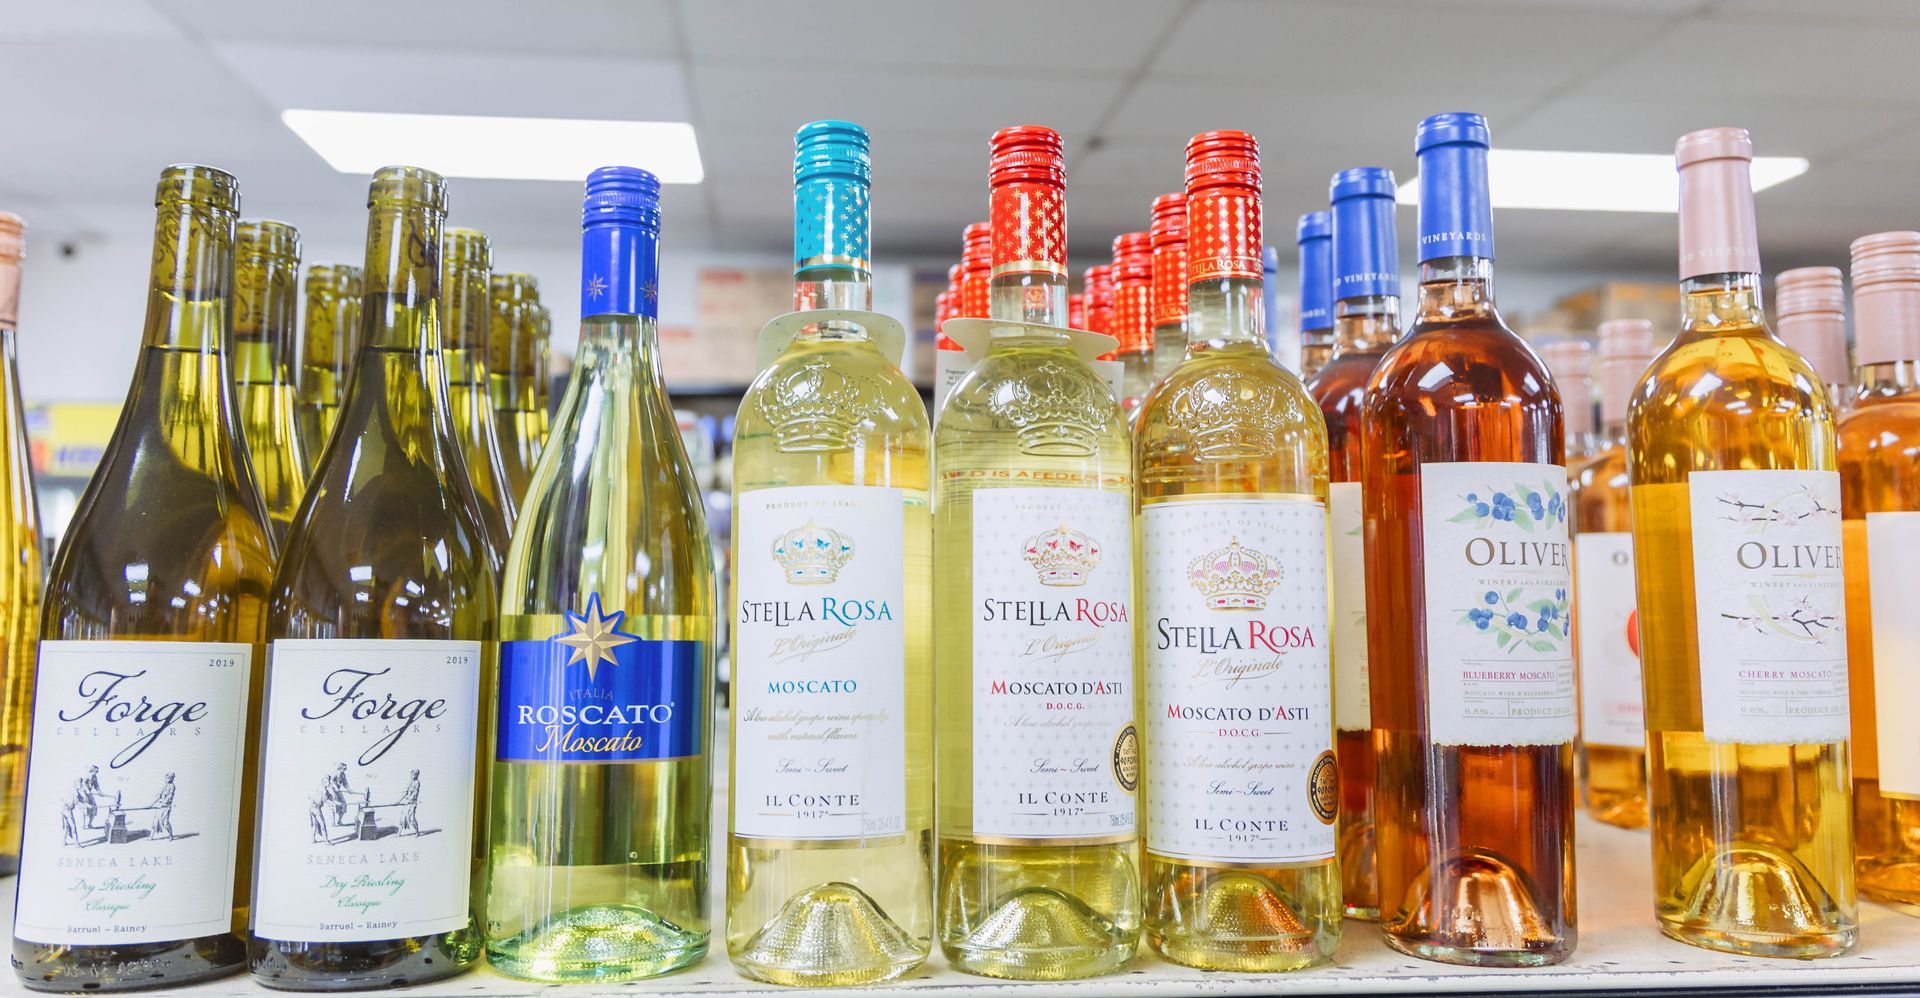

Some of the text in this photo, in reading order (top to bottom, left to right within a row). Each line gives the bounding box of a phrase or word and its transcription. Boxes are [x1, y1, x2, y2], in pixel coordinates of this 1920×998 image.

[1189, 261, 1215, 275] STELLA
[1216, 259, 1246, 271] ROSA
[1182, 519, 1231, 536] PRODUCT
[1257, 521, 1287, 535] ITALY
[1465, 537, 1570, 575] OLIVER
[1736, 541, 1844, 577] OLIVER
[742, 597, 893, 627] STELLA ROSA
[983, 598, 1128, 628] STELLA ROSA
[1157, 618, 1316, 655] STELLA ROSA
[209, 658, 235, 668] 2019
[446, 656, 469, 665] 2019
[1192, 654, 1283, 690] L'Originale
[1463, 671, 1554, 680] BLUEBERRY MOSCATO
[1739, 671, 1832, 679] CHERRY MOSCATO
[569, 687, 614, 701] ITALIA
[768, 680, 857, 694] MOSCATO
[991, 680, 1077, 695] MOSCATO
[301, 668, 446, 766] Forge
[518, 704, 673, 725] ROSCATO
[1167, 704, 1252, 721] MOSCATO
[1511, 707, 1552, 716] PRODUCT
[1788, 706, 1829, 714] PRODUCT
[58, 670, 208, 769] Forge
[535, 723, 643, 753] Moscato
[1218, 728, 1262, 737] D.O.C.G.
[776, 758, 802, 773] Semi
[814, 758, 849, 773] Sweet
[1030, 758, 1059, 773] Semi
[1070, 758, 1100, 773] Sweet
[1214, 758, 1249, 769] alcohol
[1247, 763, 1273, 773] grape
[1206, 780, 1235, 795] Semi
[1243, 781, 1275, 796] Sweet
[766, 794, 859, 807] IL CONTE
[1019, 792, 1108, 804] IL CONTE
[1195, 818, 1288, 832] IL CONTE
[57, 856, 173, 868] SENECA LAKE
[307, 852, 420, 865] SENECA LAKE
[67, 874, 157, 900] Dry Riesling
[319, 870, 405, 898] Dry Riesling
